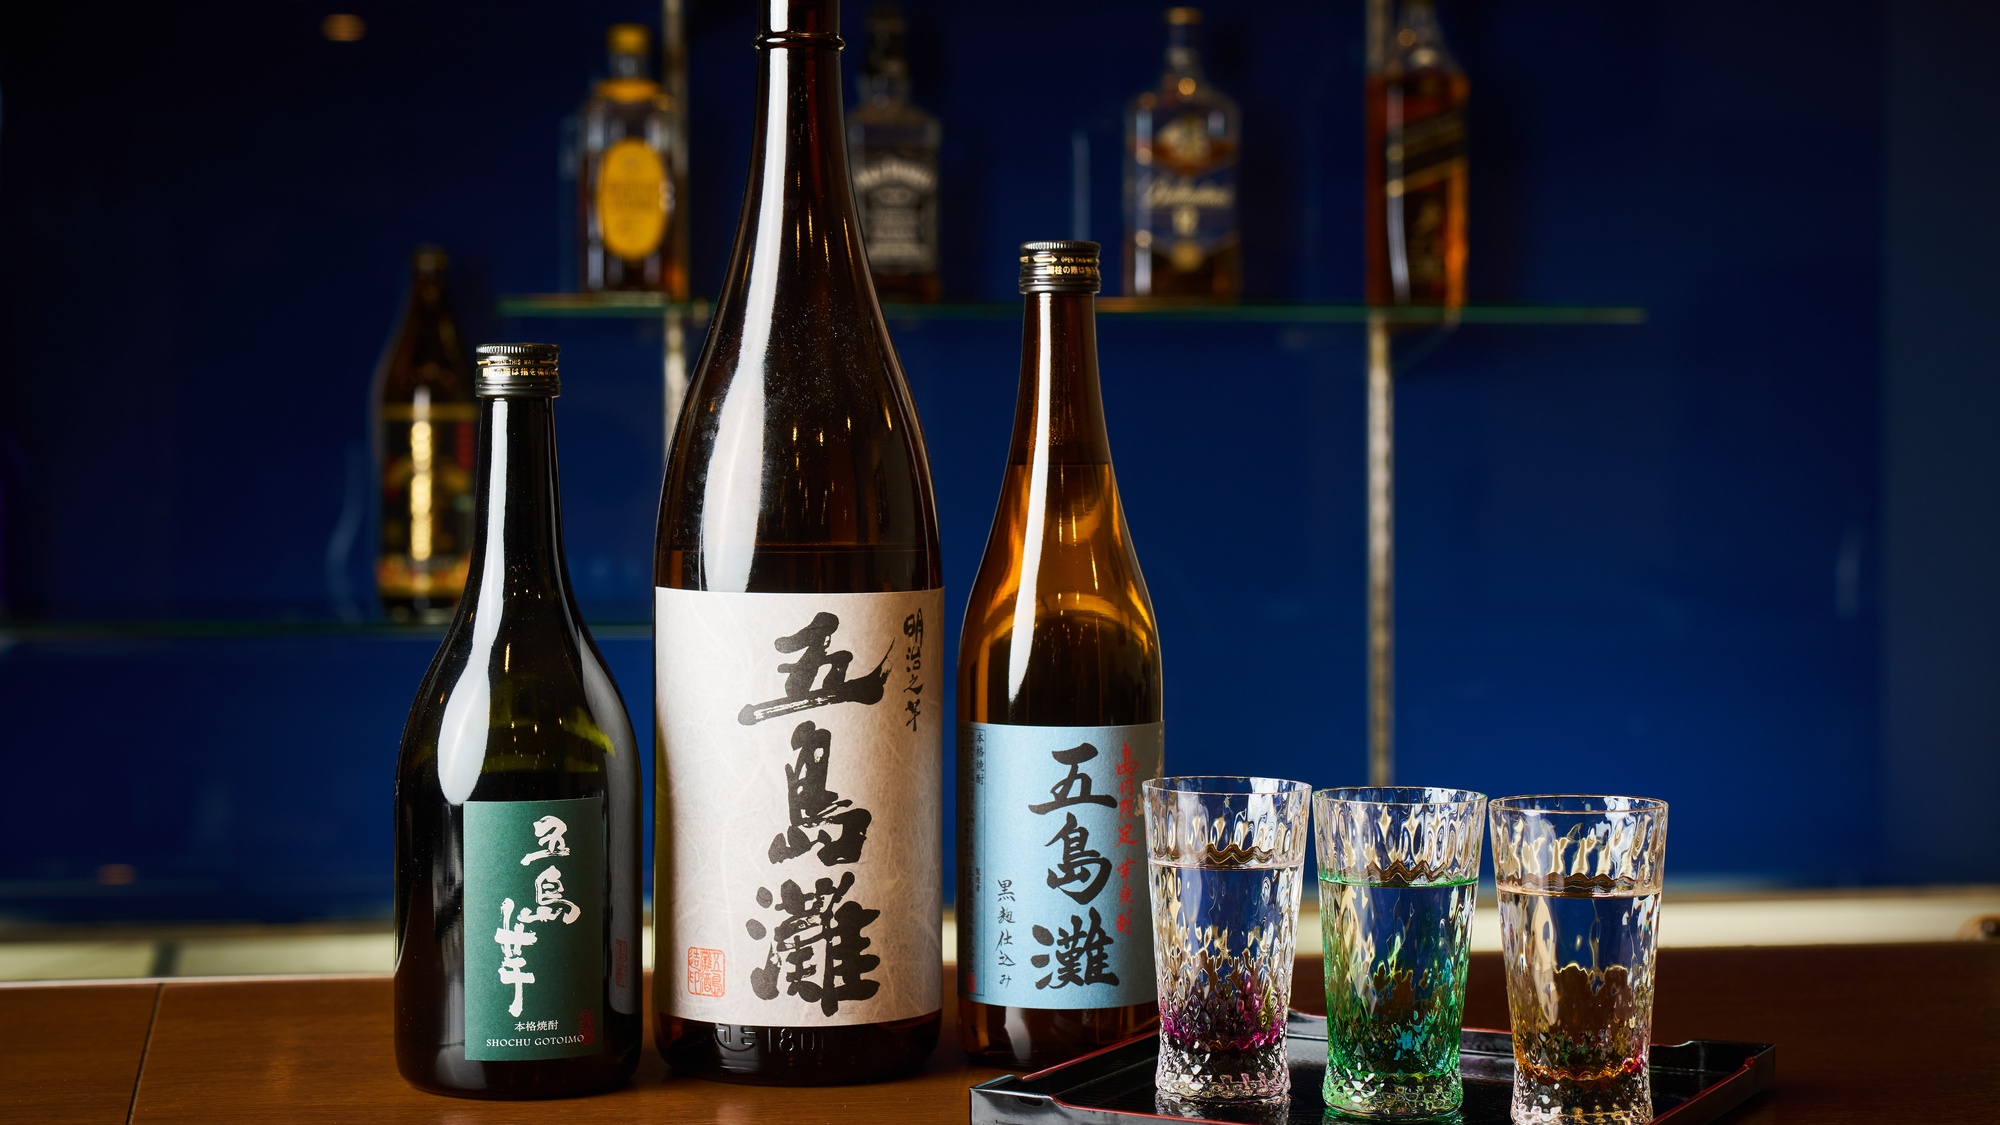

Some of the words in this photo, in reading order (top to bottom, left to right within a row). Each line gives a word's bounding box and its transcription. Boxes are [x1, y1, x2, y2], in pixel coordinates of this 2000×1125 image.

[738, 611, 895, 1018] 五島灘
[1028, 742, 1121, 991] 五島灘
[486, 1038, 531, 1047] SHOCHU
[534, 1034, 585, 1046] GOTOIMO
[514, 1019, 559, 1032] 本格焼酎
